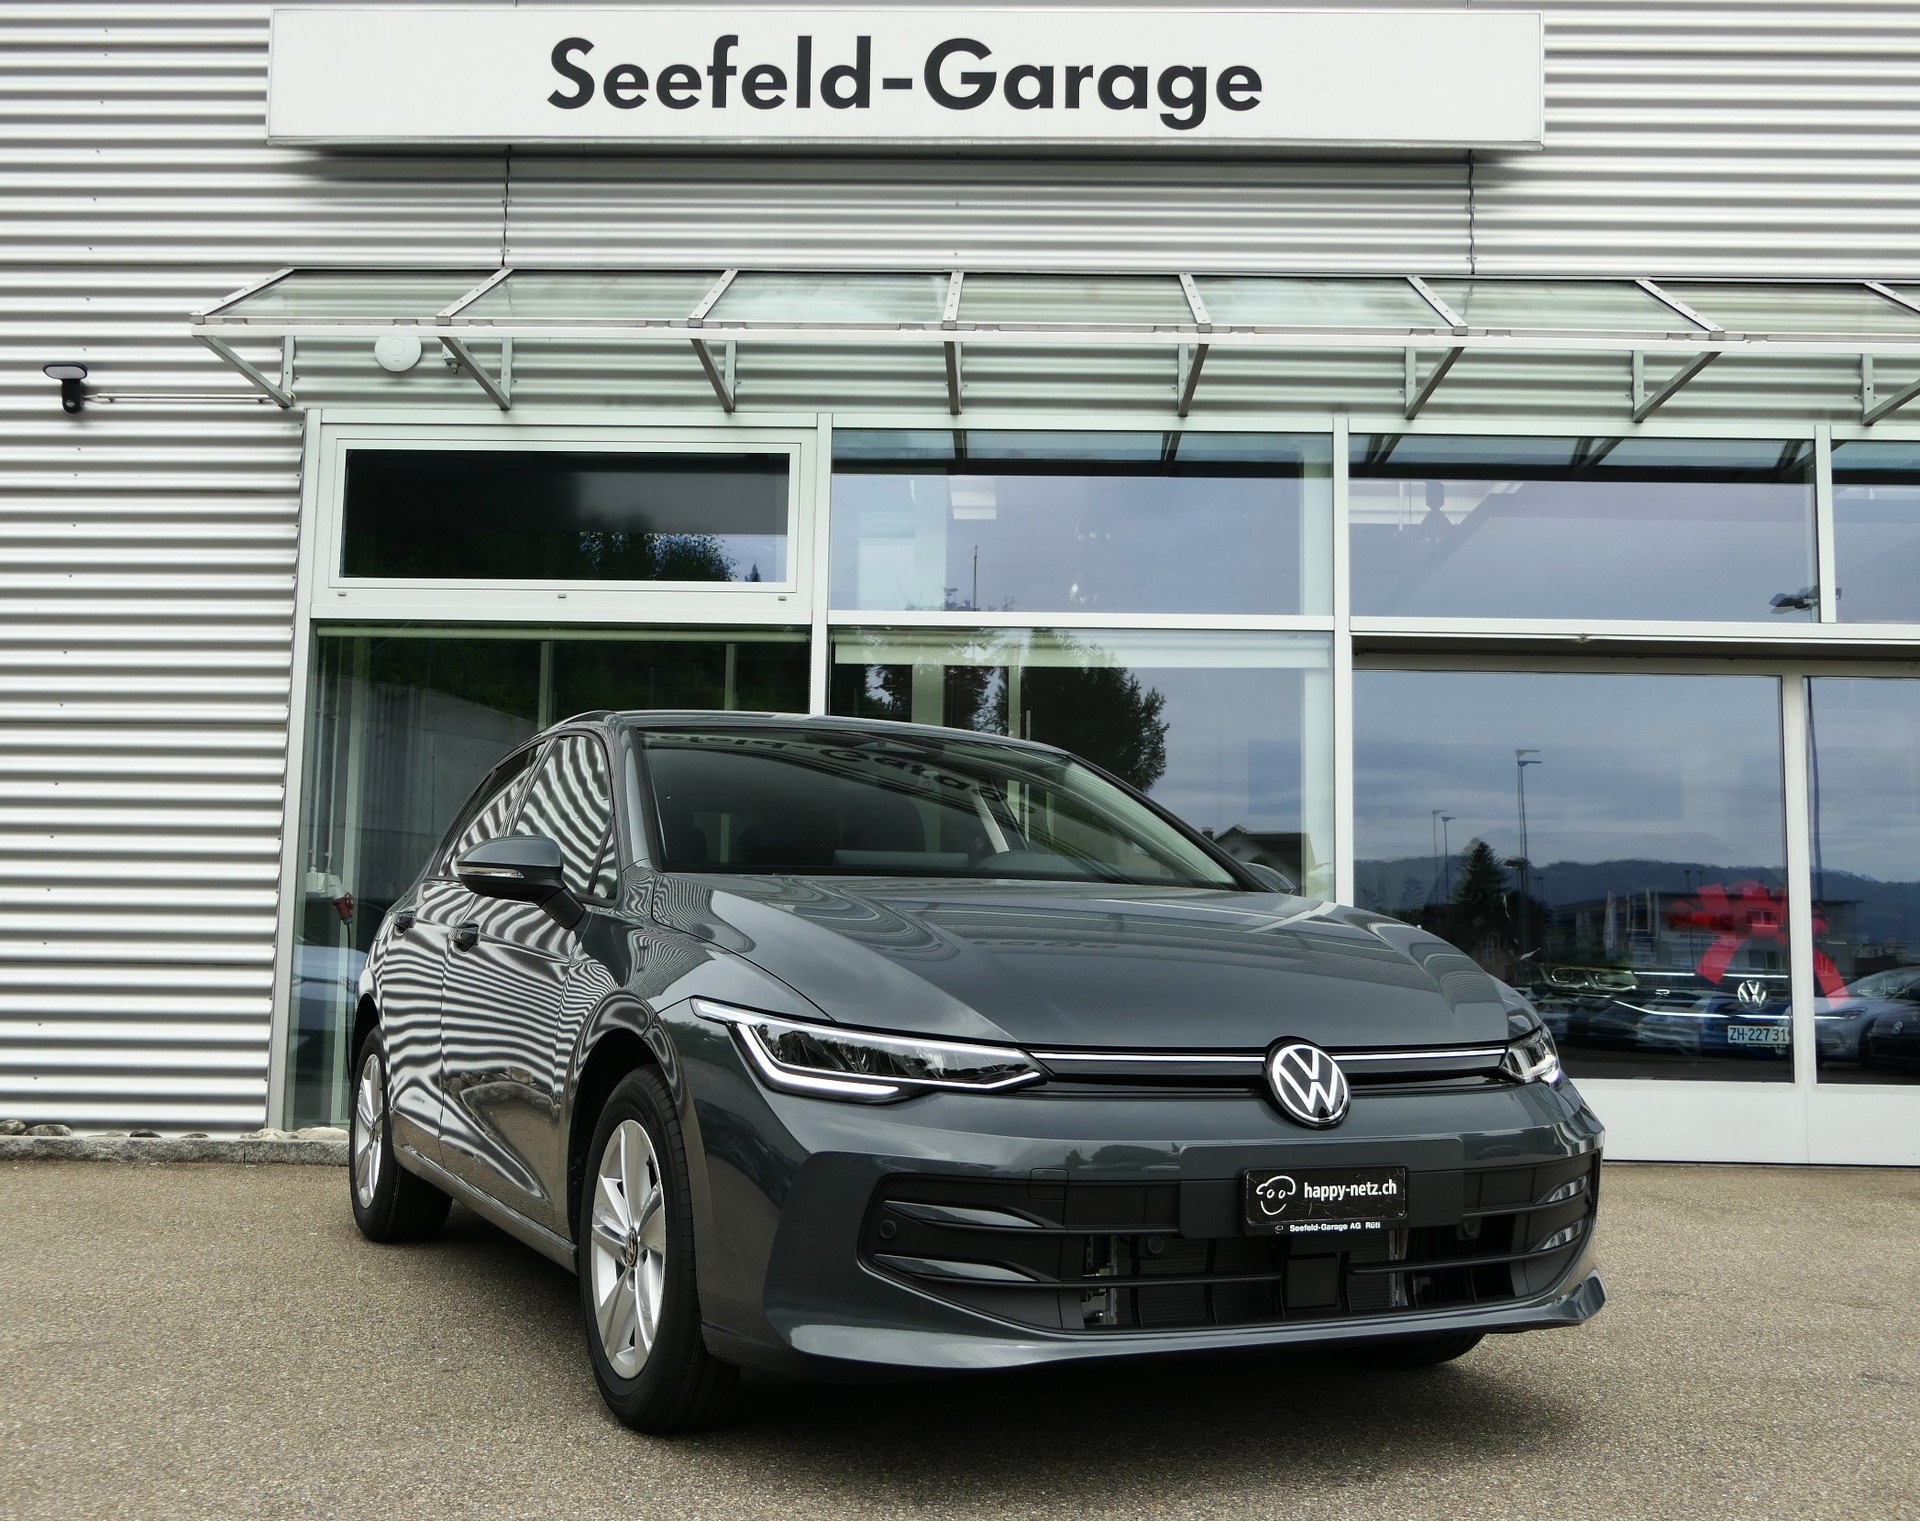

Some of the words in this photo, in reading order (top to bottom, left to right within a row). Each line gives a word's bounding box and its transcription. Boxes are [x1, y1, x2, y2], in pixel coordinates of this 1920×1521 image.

[547, 34, 1263, 131] Seefeld-Garage
[1274, 1045, 1346, 1119] VW
[1303, 1178, 1397, 1202] happy-netz.ch
[1289, 1223, 1348, 1233] Seefeld-Garage
[1349, 1222, 1362, 1231] AG
